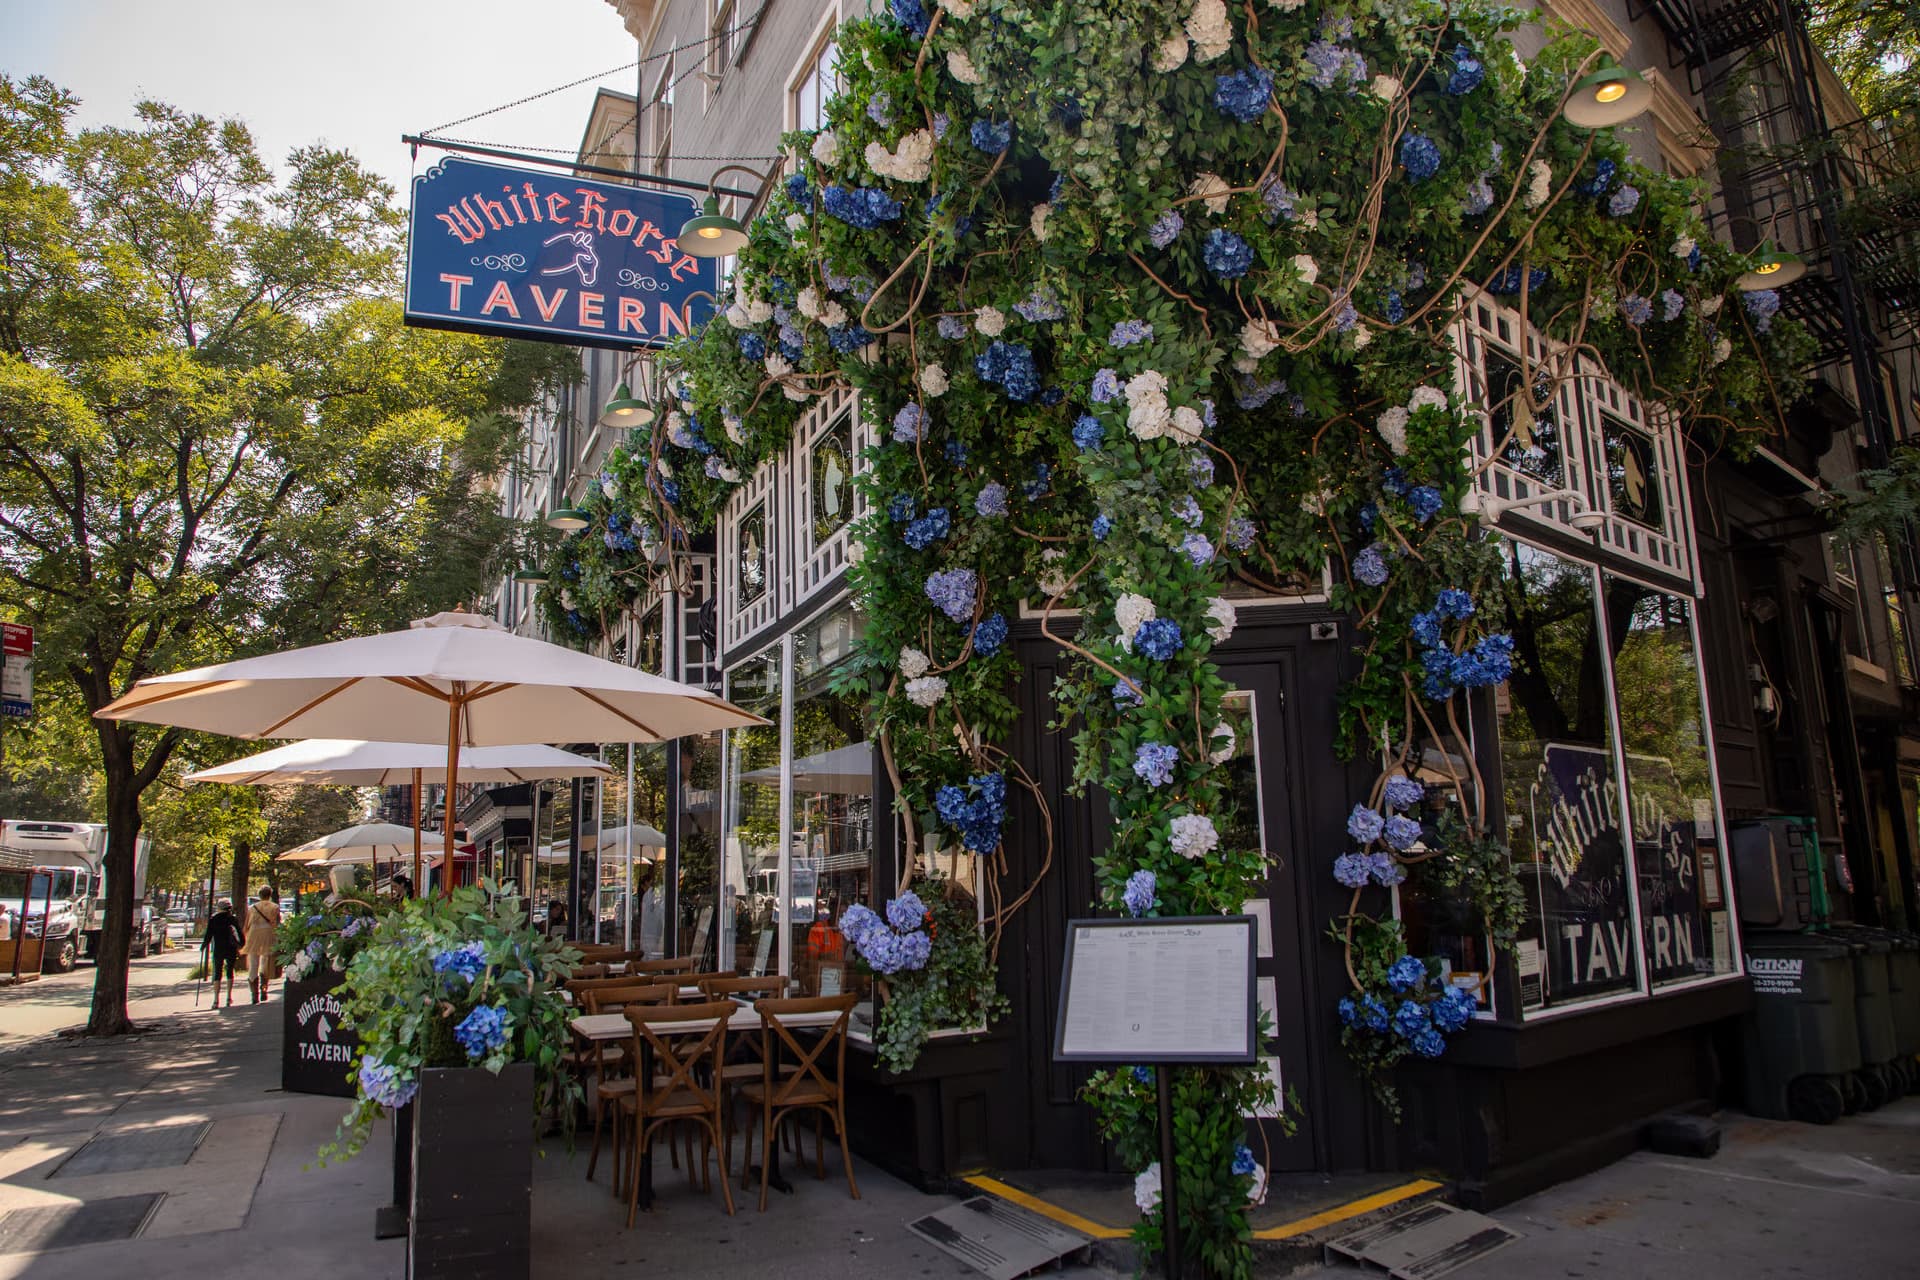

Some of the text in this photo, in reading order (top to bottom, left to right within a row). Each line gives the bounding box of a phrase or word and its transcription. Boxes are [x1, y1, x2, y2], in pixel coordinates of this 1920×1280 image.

[435, 182, 700, 283] White Horse
[439, 273, 693, 337] TAVERN
[1547, 767, 1619, 889] White
[1563, 914, 1694, 984] TAVRN
[297, 995, 325, 1026] White
[299, 1042, 351, 1062] TAVERN
